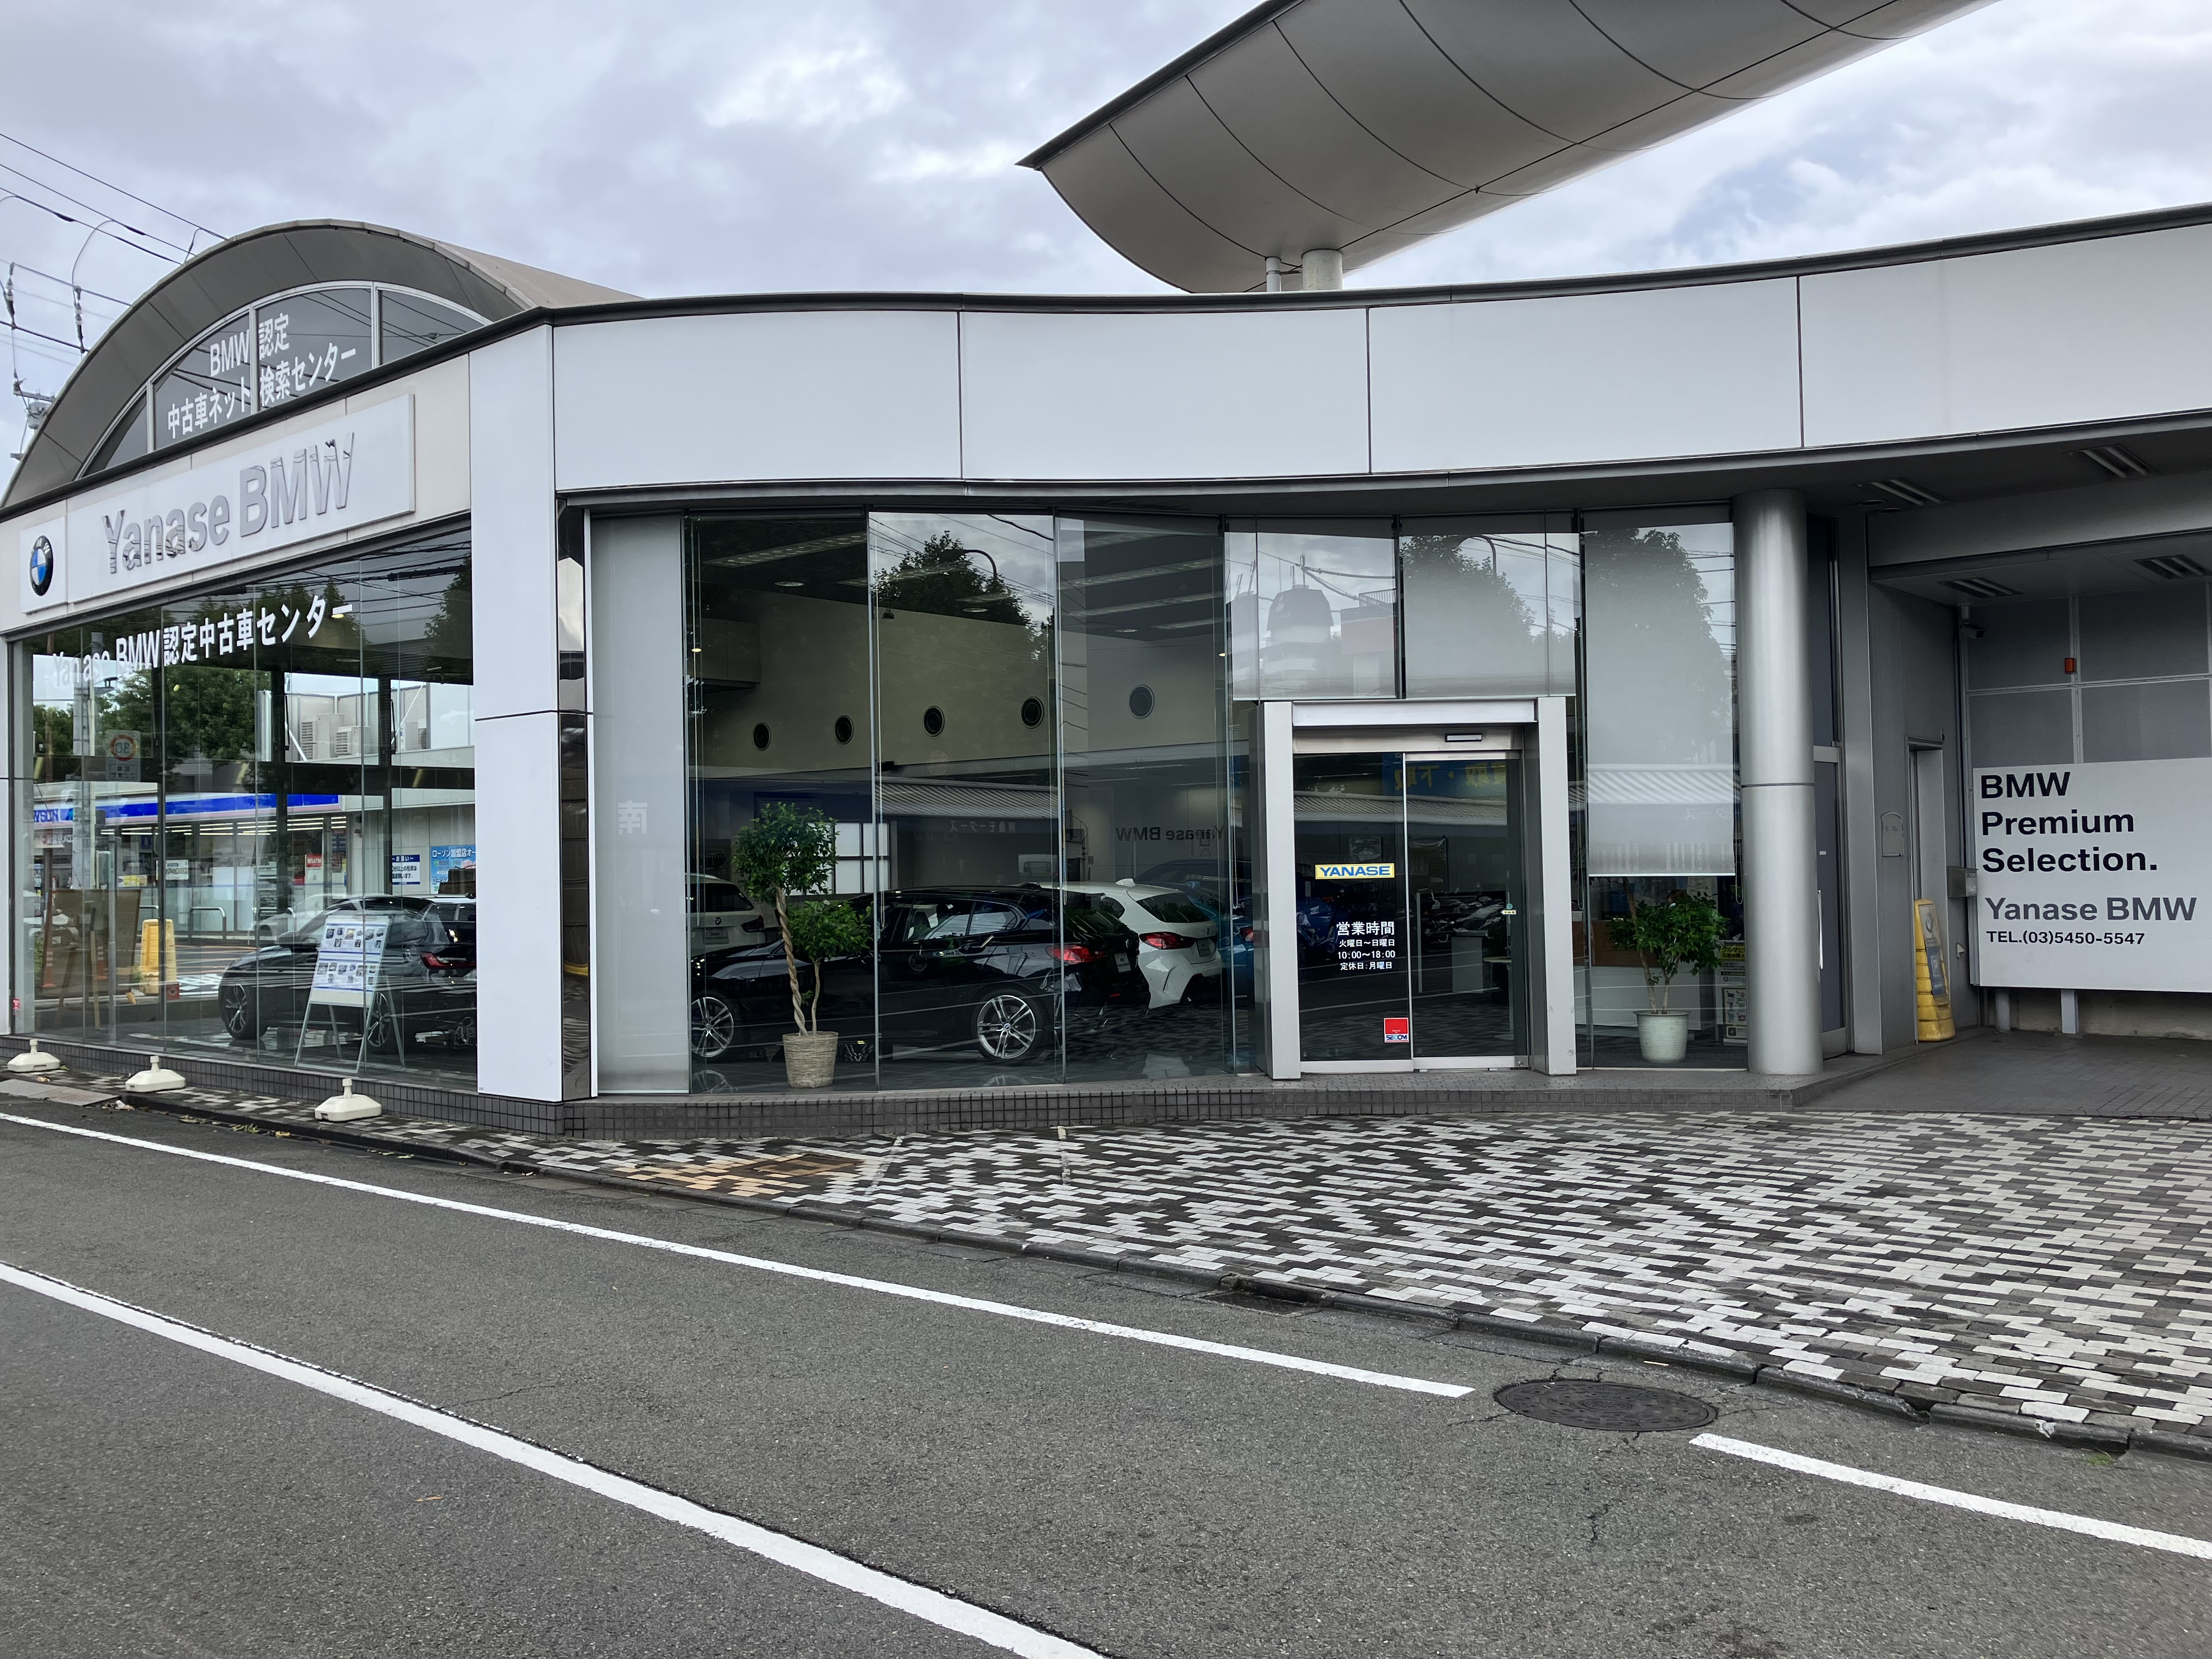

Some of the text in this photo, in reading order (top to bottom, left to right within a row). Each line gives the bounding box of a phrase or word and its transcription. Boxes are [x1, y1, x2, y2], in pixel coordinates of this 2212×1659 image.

[210, 313, 289, 377] BMW 認定
[168, 342, 356, 438] 中古車ネット 検索センター
[101, 432, 354, 574] Yanase BMW
[1980, 771, 2070, 799] BMW
[1982, 809, 2134, 836] Premium
[1319, 866, 1391, 877] YANASE
[1983, 847, 2158, 872] Selection.
[1985, 897, 2197, 921] Yanase BMW
[1336, 921, 1395, 935] 営業時間
[1987, 930, 2145, 945] TEL.(03)5450-5547
[1338, 950, 1396, 959] 10:00～18:00
[1339, 939, 1395, 947] 火曜日～日曜日
